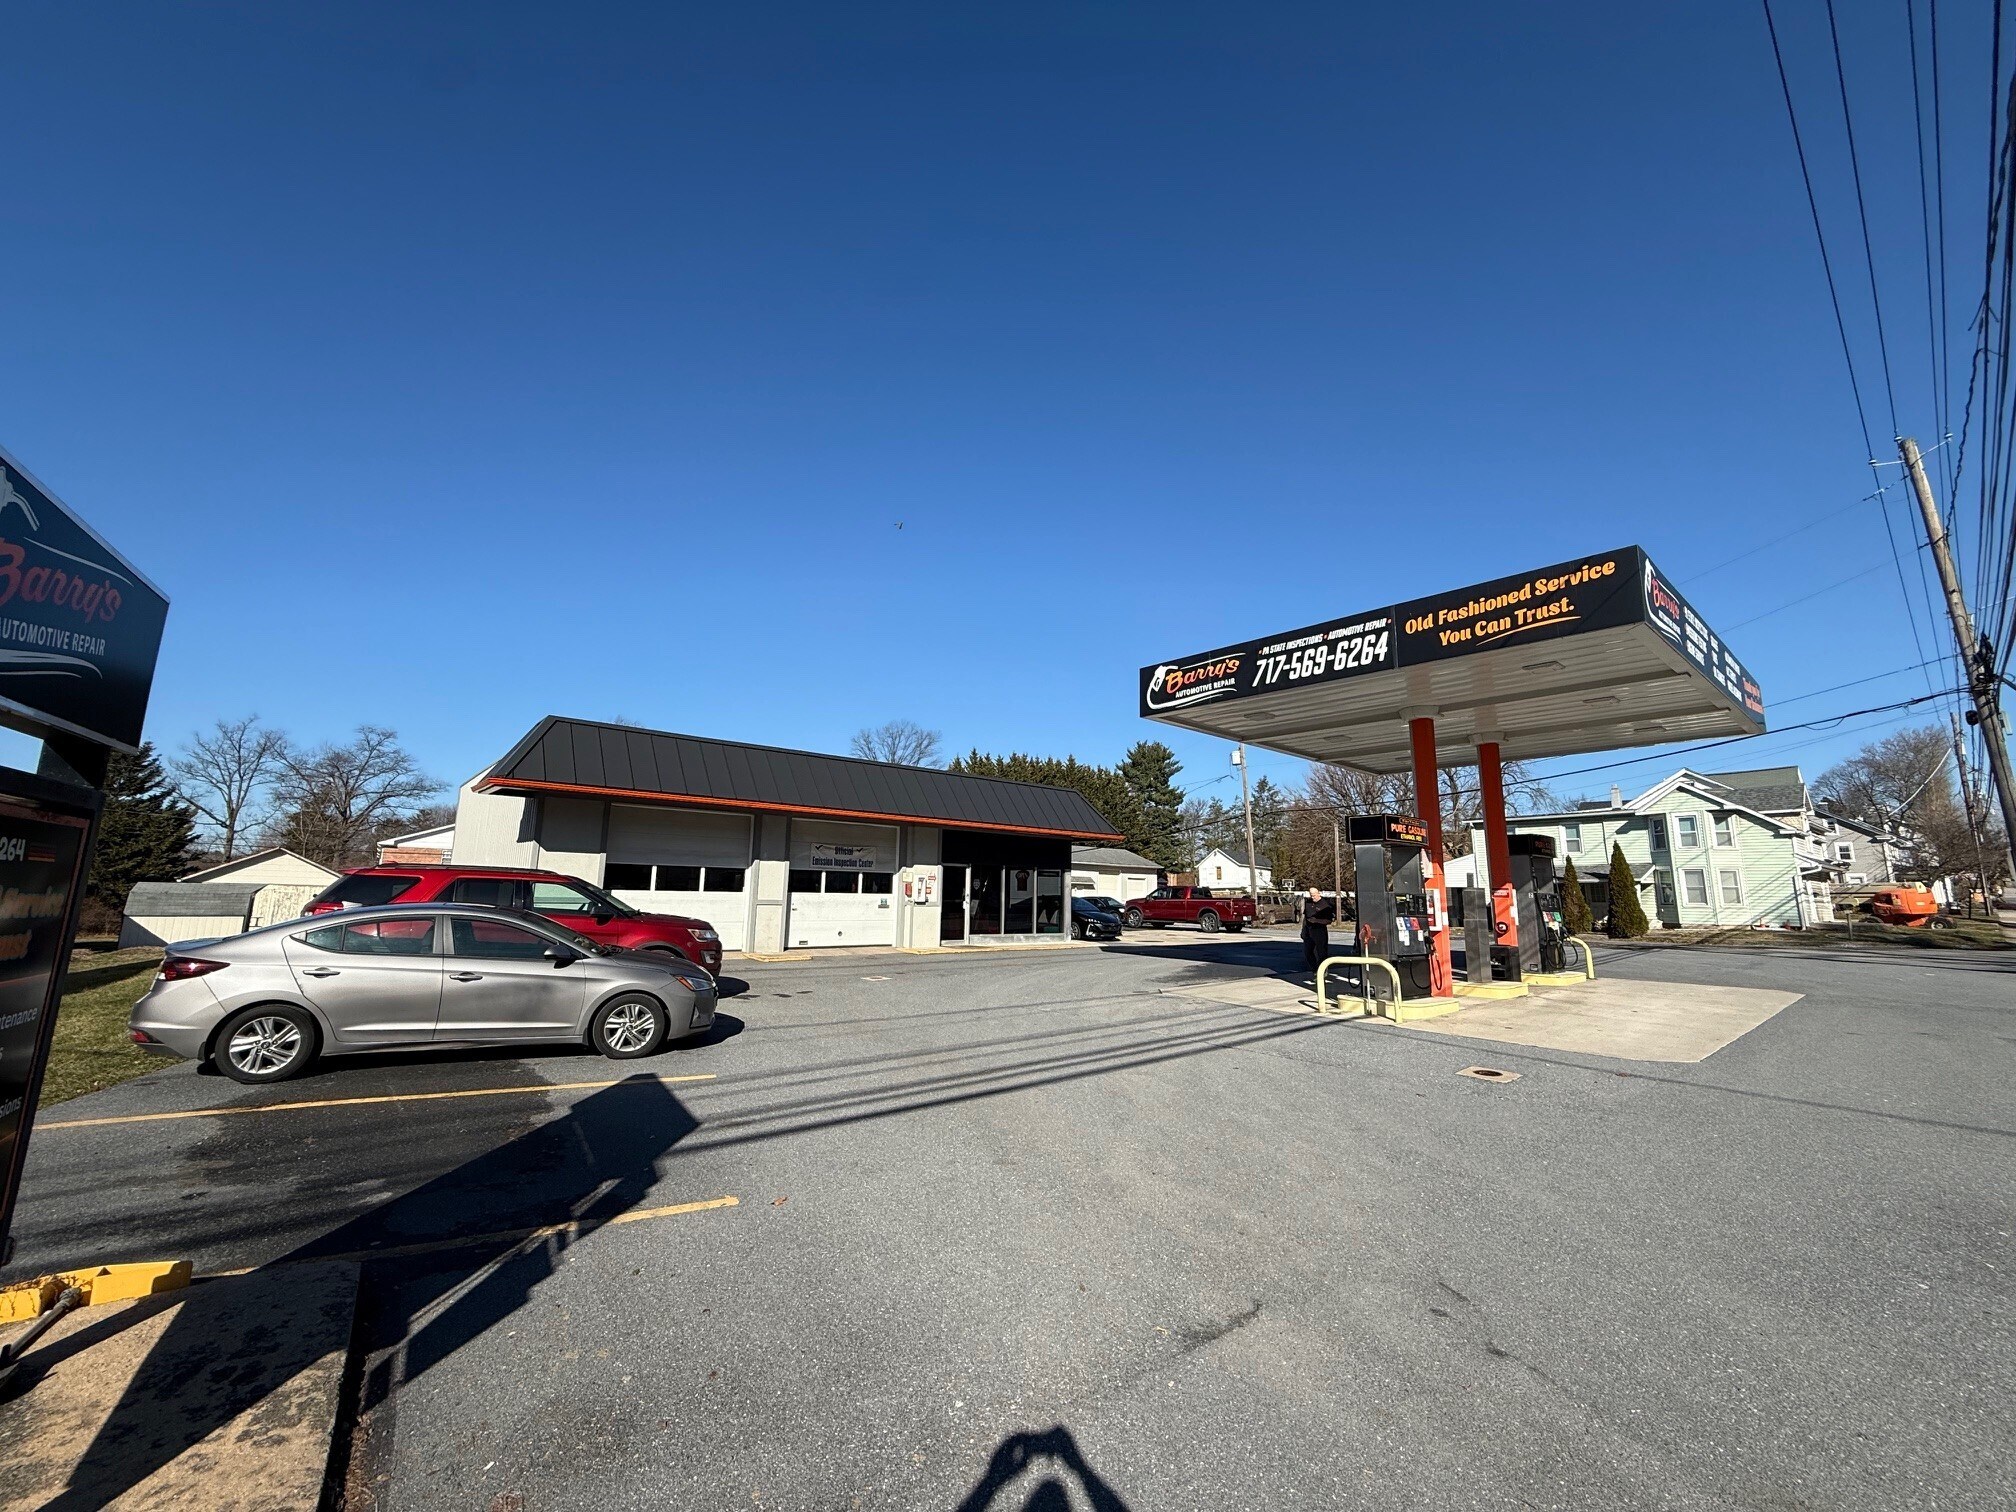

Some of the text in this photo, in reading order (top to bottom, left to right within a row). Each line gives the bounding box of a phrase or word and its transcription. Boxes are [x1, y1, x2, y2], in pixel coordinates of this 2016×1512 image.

[0, 538, 122, 623] Barry's
[1405, 560, 1616, 635] Old Fashioned Service
[0, 617, 106, 656] UTOMOTIVE REPAIR
[1270, 641, 1286, 654] STATE
[1286, 633, 1323, 650] INSPECTIONS
[1327, 623, 1365, 640] AUTOMOTIVE
[1364, 617, 1387, 632] REPAIR
[1439, 596, 1575, 646] You Can Trust.
[1166, 658, 1240, 694] Barry's
[1252, 630, 1389, 688] 717-569-6264
[1176, 677, 1236, 698] AUTOMOTIVE REPAIR
[1391, 823, 1406, 833] PURE
[812, 856, 874, 868] Emission Inspection Center
[835, 846, 854, 855] Official
